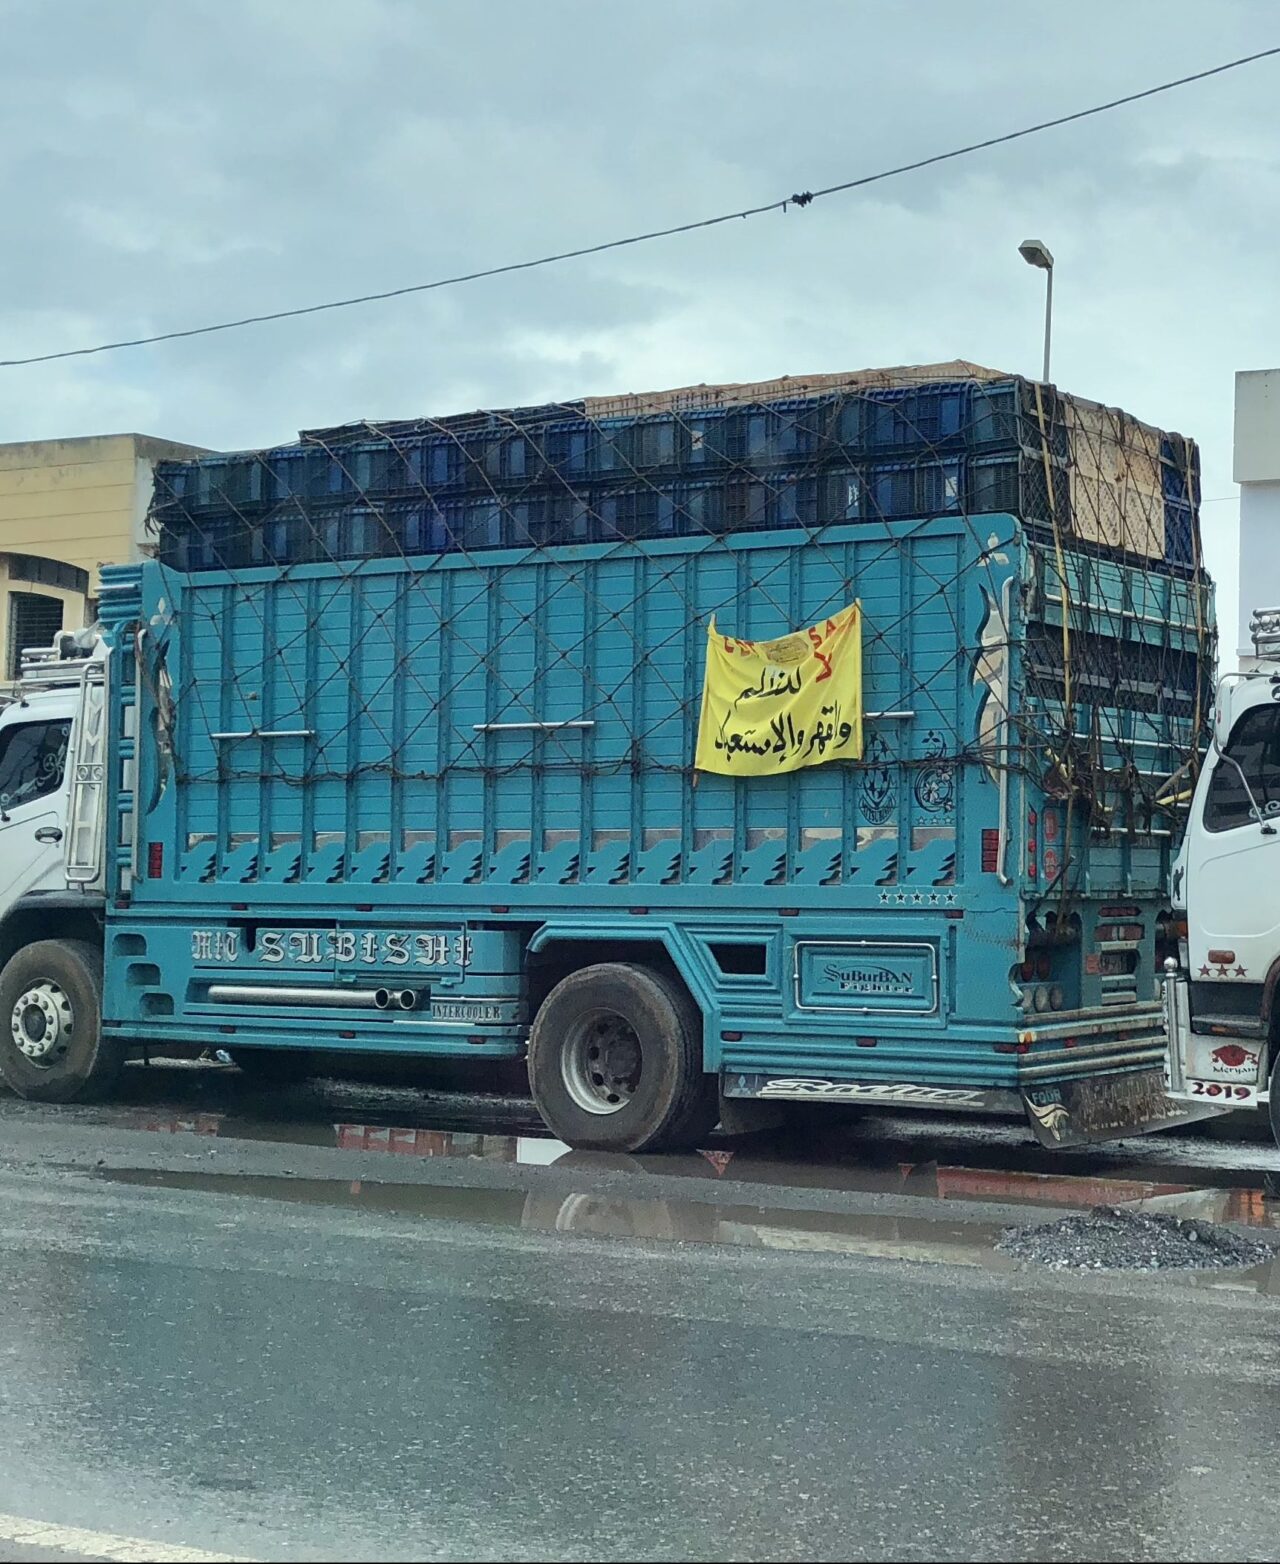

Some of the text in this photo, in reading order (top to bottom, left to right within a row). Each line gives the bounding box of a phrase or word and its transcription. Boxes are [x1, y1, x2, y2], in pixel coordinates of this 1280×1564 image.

[840, 982, 914, 994] Fighter
[432, 1004, 502, 1020] INTERCOOLER
[757, 1078, 985, 1107] Racing
[1192, 1082, 1251, 1101] 2019
